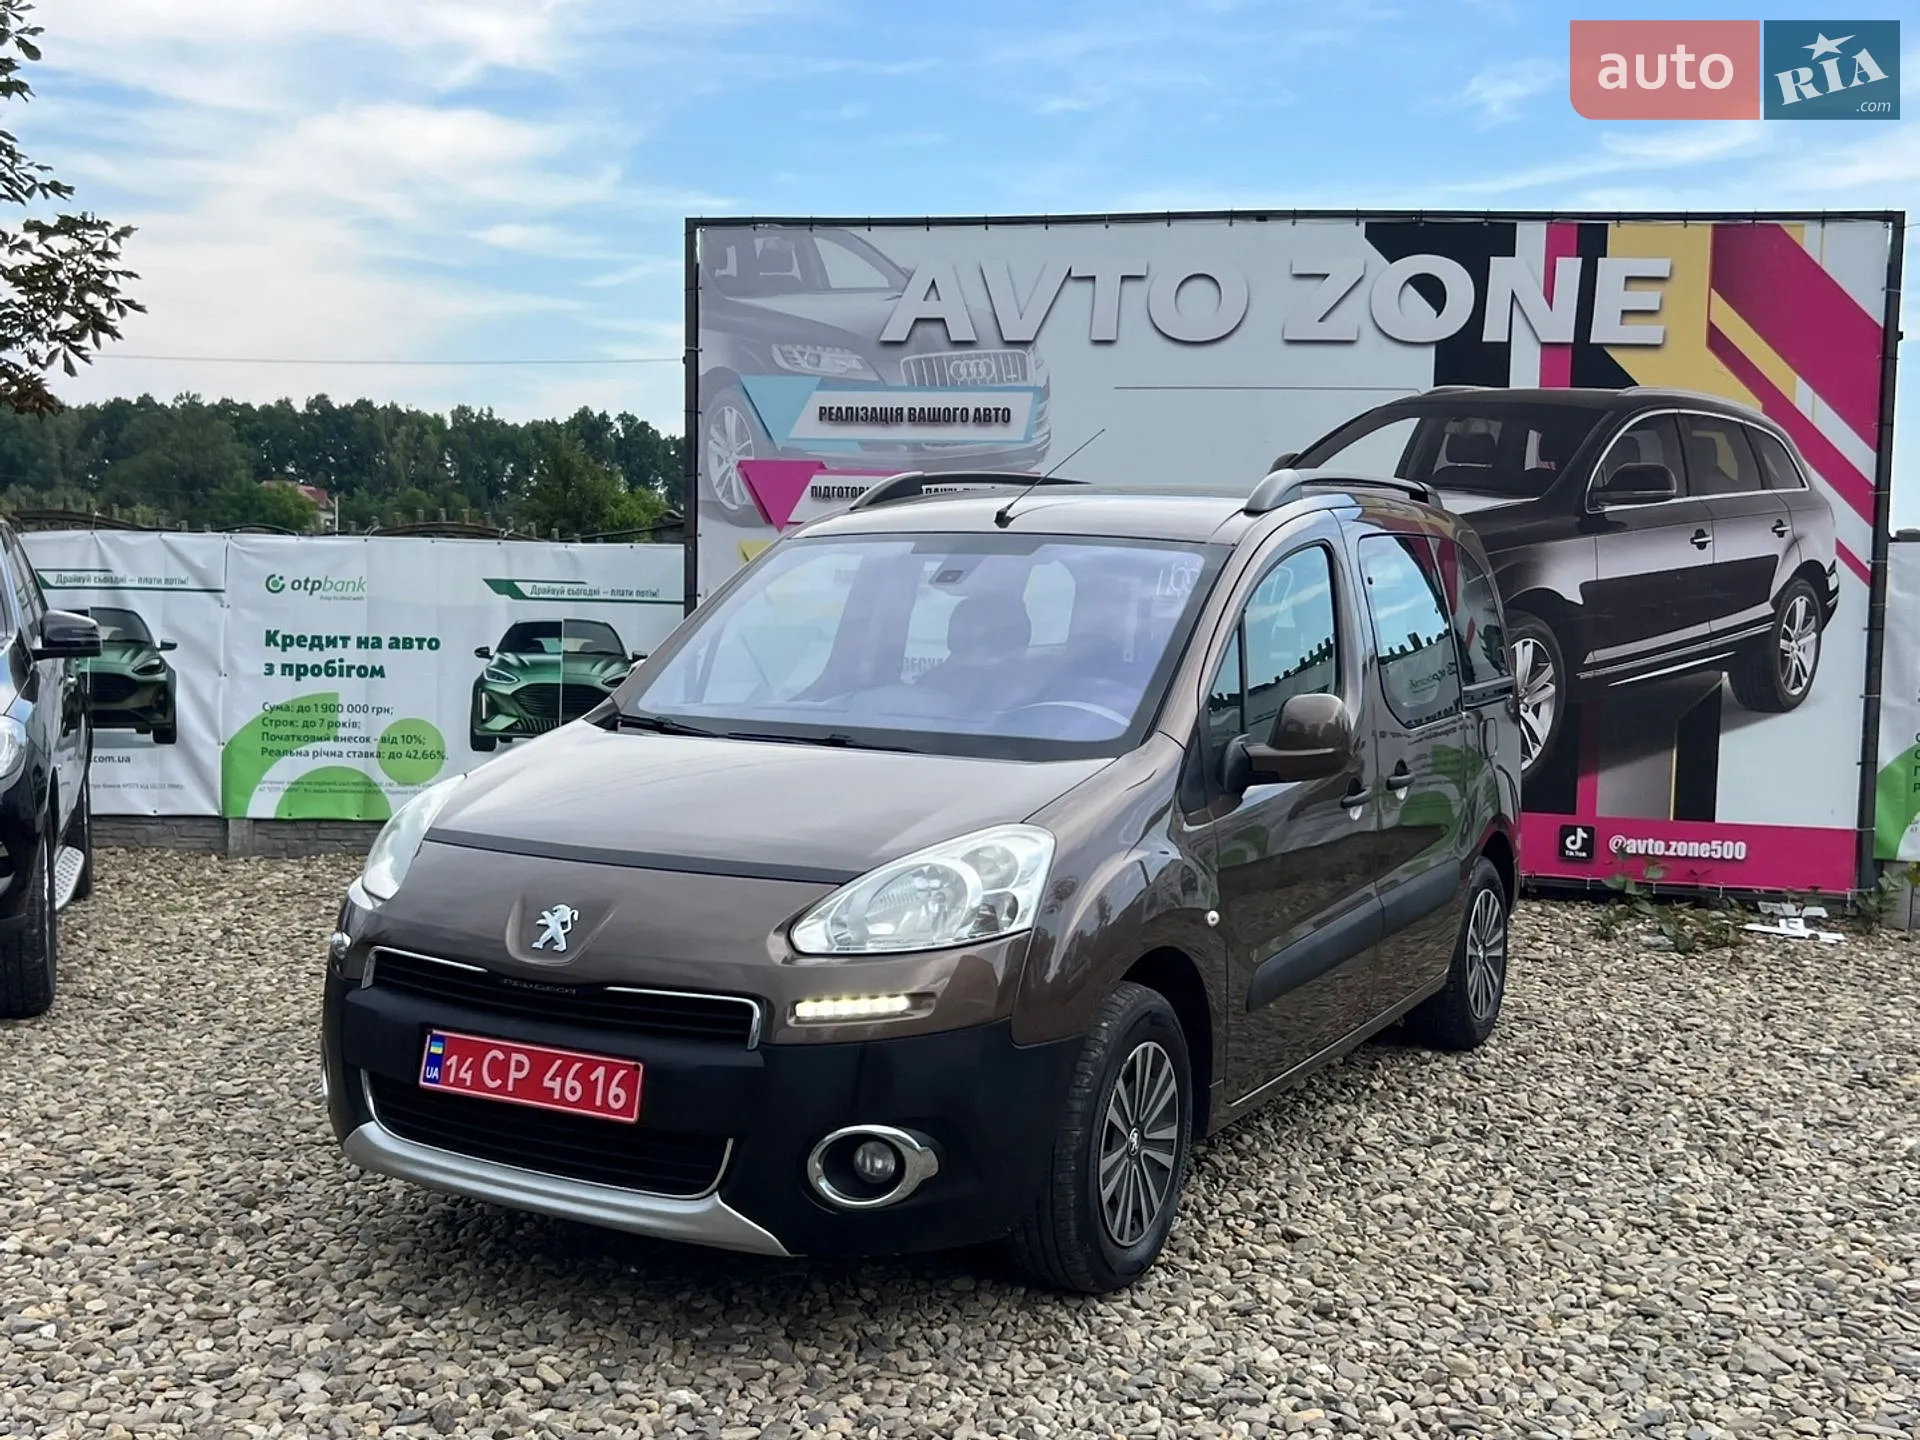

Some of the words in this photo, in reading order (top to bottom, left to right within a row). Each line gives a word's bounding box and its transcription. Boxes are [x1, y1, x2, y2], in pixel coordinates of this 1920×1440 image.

[878, 258, 1250, 344] AVTO
[1282, 254, 1673, 346] ZONE
[818, 405, 904, 425] РЕАЛІЗАЦІЯ
[907, 406, 970, 424] ВАШОГО
[972, 406, 1011, 424] АВТО
[290, 575, 366, 596] otpbank
[264, 629, 351, 651] Кредит
[356, 635, 383, 650] на
[387, 636, 441, 651] авто
[263, 662, 276, 676] з
[280, 658, 386, 681] пробігом
[262, 701, 294, 714] Сума:
[296, 704, 311, 715] до
[371, 705, 394, 717] грн;
[261, 717, 300, 729] Строк:
[301, 720, 317, 730] до
[318, 718, 325, 729] 7
[327, 718, 361, 730] років;
[261, 732, 331, 744] Початковий
[333, 734, 372, 744] внесок
[380, 734, 399, 745] від
[401, 734, 426, 746] 10%;
[260, 746, 310, 758] Реальна
[312, 748, 344, 760] річна
[346, 750, 386, 760] ставка:
[387, 750, 403, 761] до
[1608, 834, 1747, 860] @avto.zone500
[425, 1066, 440, 1080] UA
[446, 1054, 475, 1087] 14
[481, 1049, 530, 1092] CP
[542, 1058, 628, 1110] 4616
